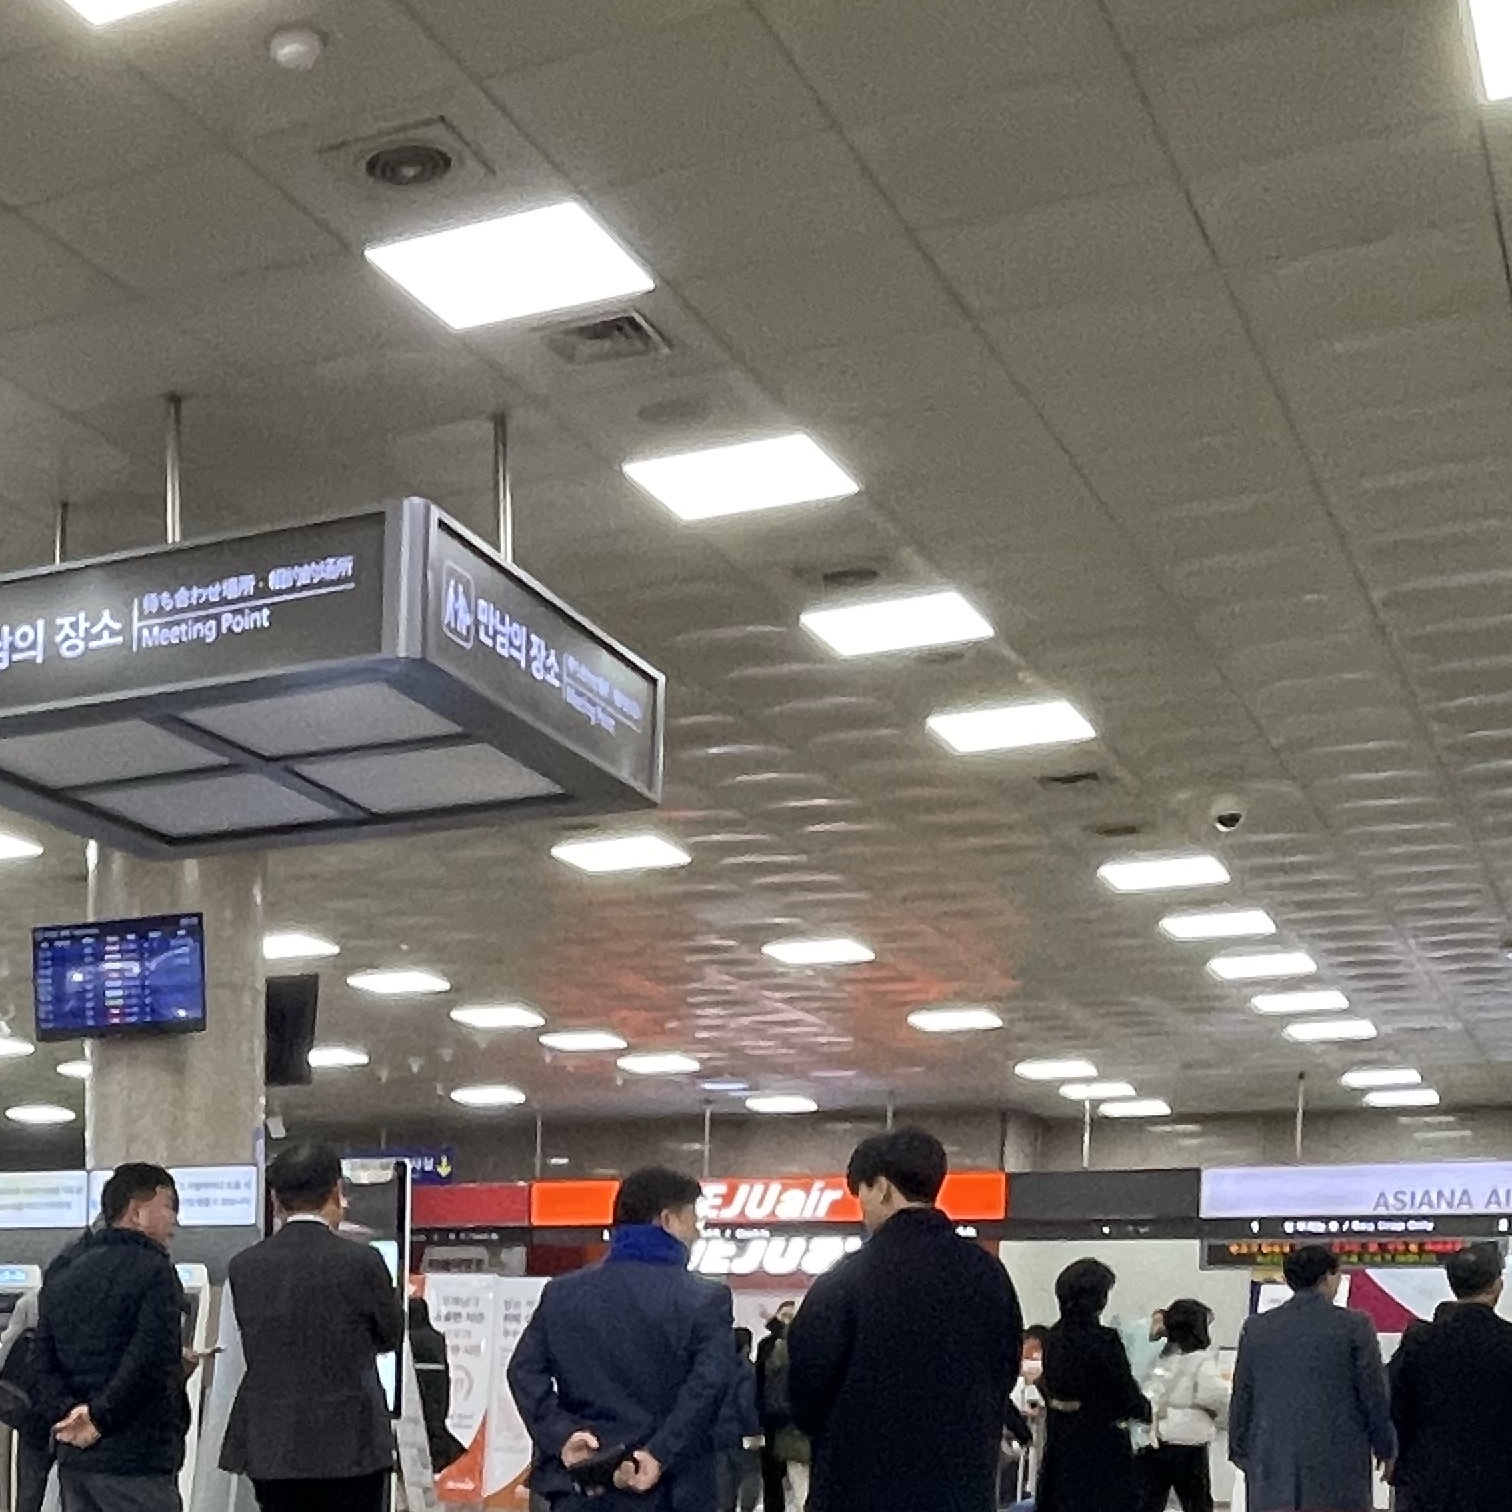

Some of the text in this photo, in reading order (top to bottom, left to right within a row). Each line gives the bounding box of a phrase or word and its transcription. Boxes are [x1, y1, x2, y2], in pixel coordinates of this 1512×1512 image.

[55, 609, 124, 658] 장소
[142, 607, 271, 647] Meeting Point
[477, 598, 561, 688] 만남의 장소
[695, 1180, 844, 1220] EJUair
[1372, 1188, 1474, 1212] ASIANA
